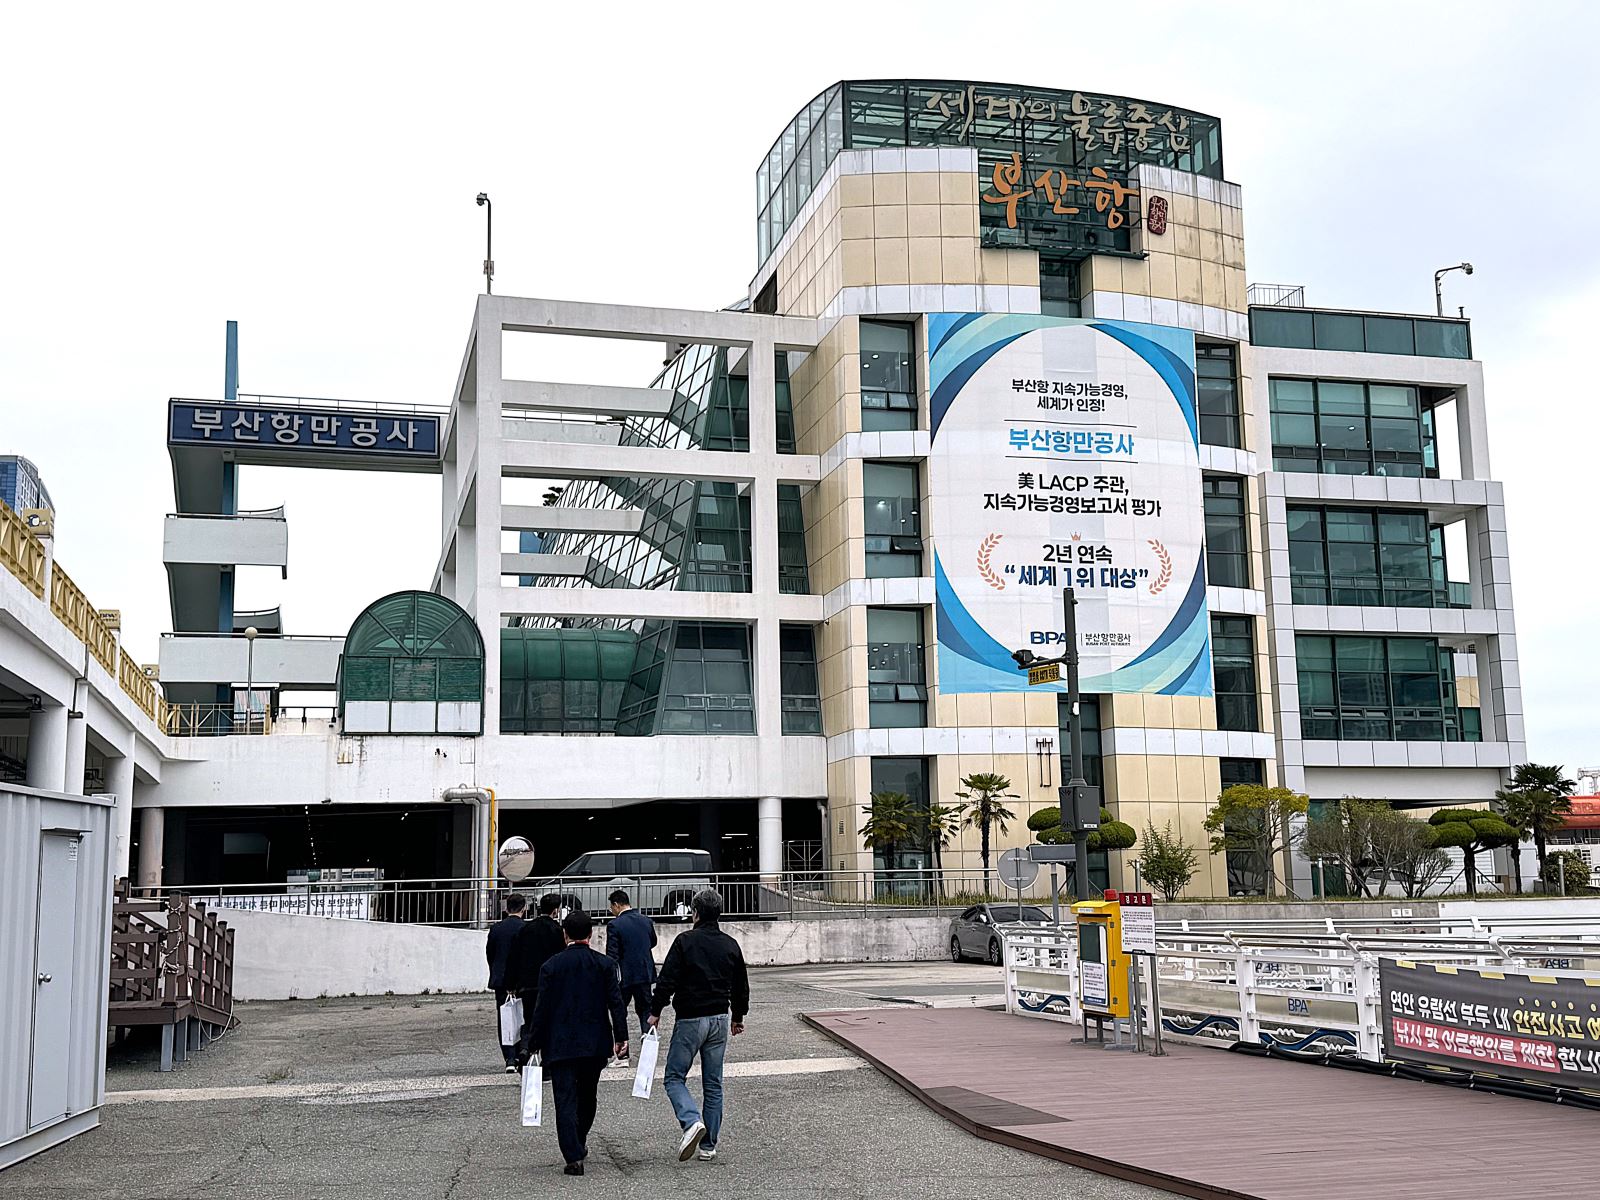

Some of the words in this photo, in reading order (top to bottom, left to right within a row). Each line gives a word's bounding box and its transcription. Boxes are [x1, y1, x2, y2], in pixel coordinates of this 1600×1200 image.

[927, 85, 1056, 143] 세계의
[1063, 92, 1191, 154] 물류중심
[982, 153, 1139, 229] 부산항
[1011, 378, 1049, 393] 부산항
[1052, 381, 1128, 400] 지속가능경영,
[1037, 396, 1073, 412] 세계가
[1077, 398, 1105, 412] 인정!
[191, 407, 419, 450] 부산항만공사
[1009, 428, 1134, 456] 부산항만공사
[1018, 472, 1034, 490] 美
[1039, 475, 1088, 492] LACP
[1093, 475, 1129, 495] 주관,
[983, 493, 1127, 515] 지속가능경영보고서
[1131, 499, 1161, 517] 평가
[1042, 544, 1073, 563] 2년
[1077, 545, 1112, 565] 연속
[1063, 567, 1095, 588] 1위
[1085, 632, 1131, 643] 부산항만공사
[1288, 998, 1309, 1013] BPA
[1390, 990, 1415, 1016] 연안
[1418, 995, 1458, 1023] 유람선
[1461, 1002, 1490, 1028] 부두
[1493, 1007, 1512, 1032] 내
[1513, 1009, 1585, 1039] 안전사고
[1396, 1020, 1422, 1046] 낚시
[1425, 1026, 1440, 1050] 및
[1442, 1030, 1517, 1062] 어로행위를
[1557, 1046, 1600, 1074] 합니
